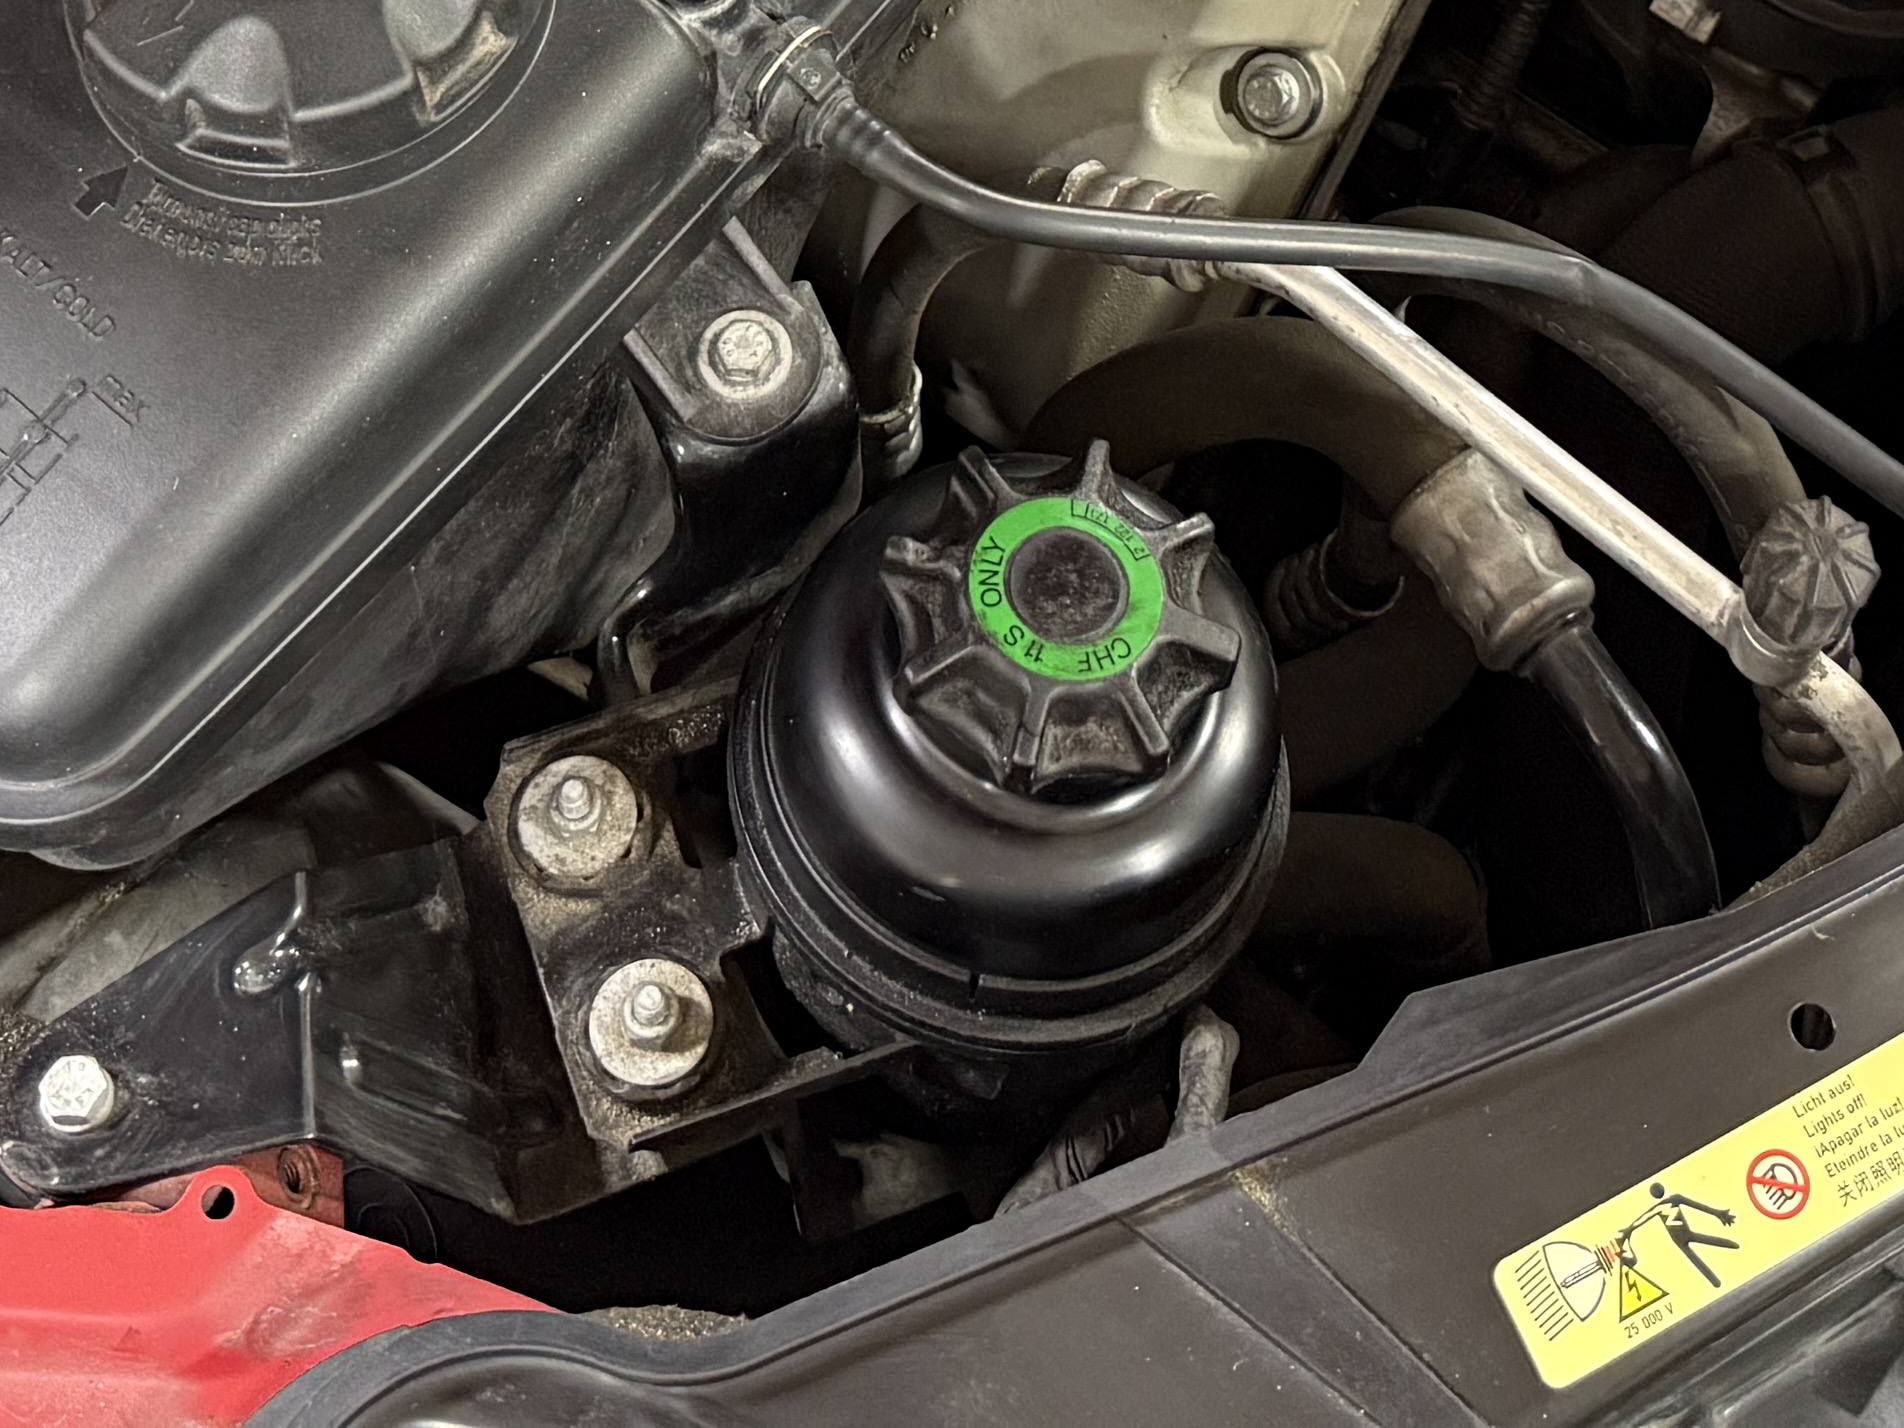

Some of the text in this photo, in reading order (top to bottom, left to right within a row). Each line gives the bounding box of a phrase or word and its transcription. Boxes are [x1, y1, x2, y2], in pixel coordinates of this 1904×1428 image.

[978, 535, 1006, 608] ONLY
[1077, 637, 1132, 673] CHF
[1792, 1073, 1854, 1118] Licht aus!
[1864, 1115, 1879, 1128] la
[1878, 1096, 1904, 1120] luz!
[1802, 1093, 1864, 1137] Lights off!
[1878, 1133, 1892, 1146] la
[1623, 1302, 1673, 1338] 25 000 V
